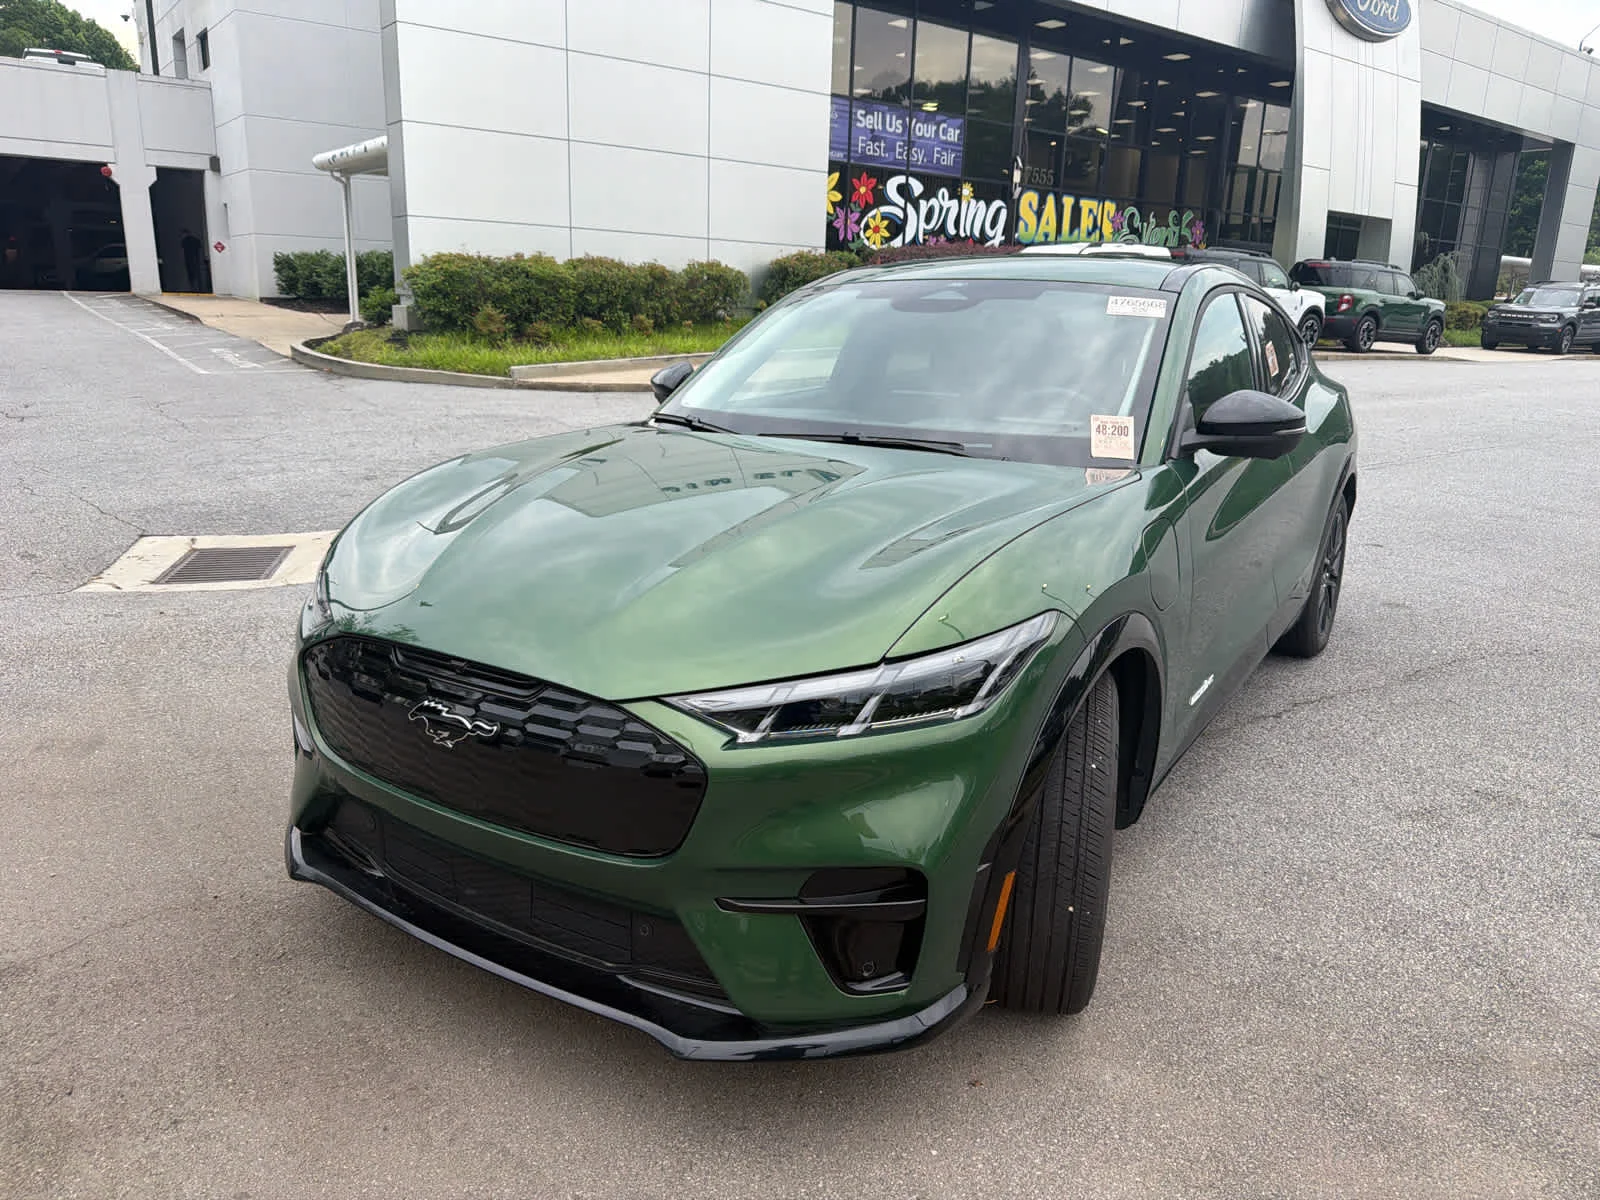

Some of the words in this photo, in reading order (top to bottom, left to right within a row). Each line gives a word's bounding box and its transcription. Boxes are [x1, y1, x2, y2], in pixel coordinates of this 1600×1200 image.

[856, 109, 882, 131] Sell
[886, 113, 903, 133] Us
[906, 117, 937, 139] Your
[939, 123, 961, 142] Car
[858, 136, 889, 158] Fast.
[933, 147, 956, 167] Fair
[1023, 166, 1055, 186] 7555
[860, 175, 1008, 249] Spring
[1017, 190, 1117, 245] SALES
